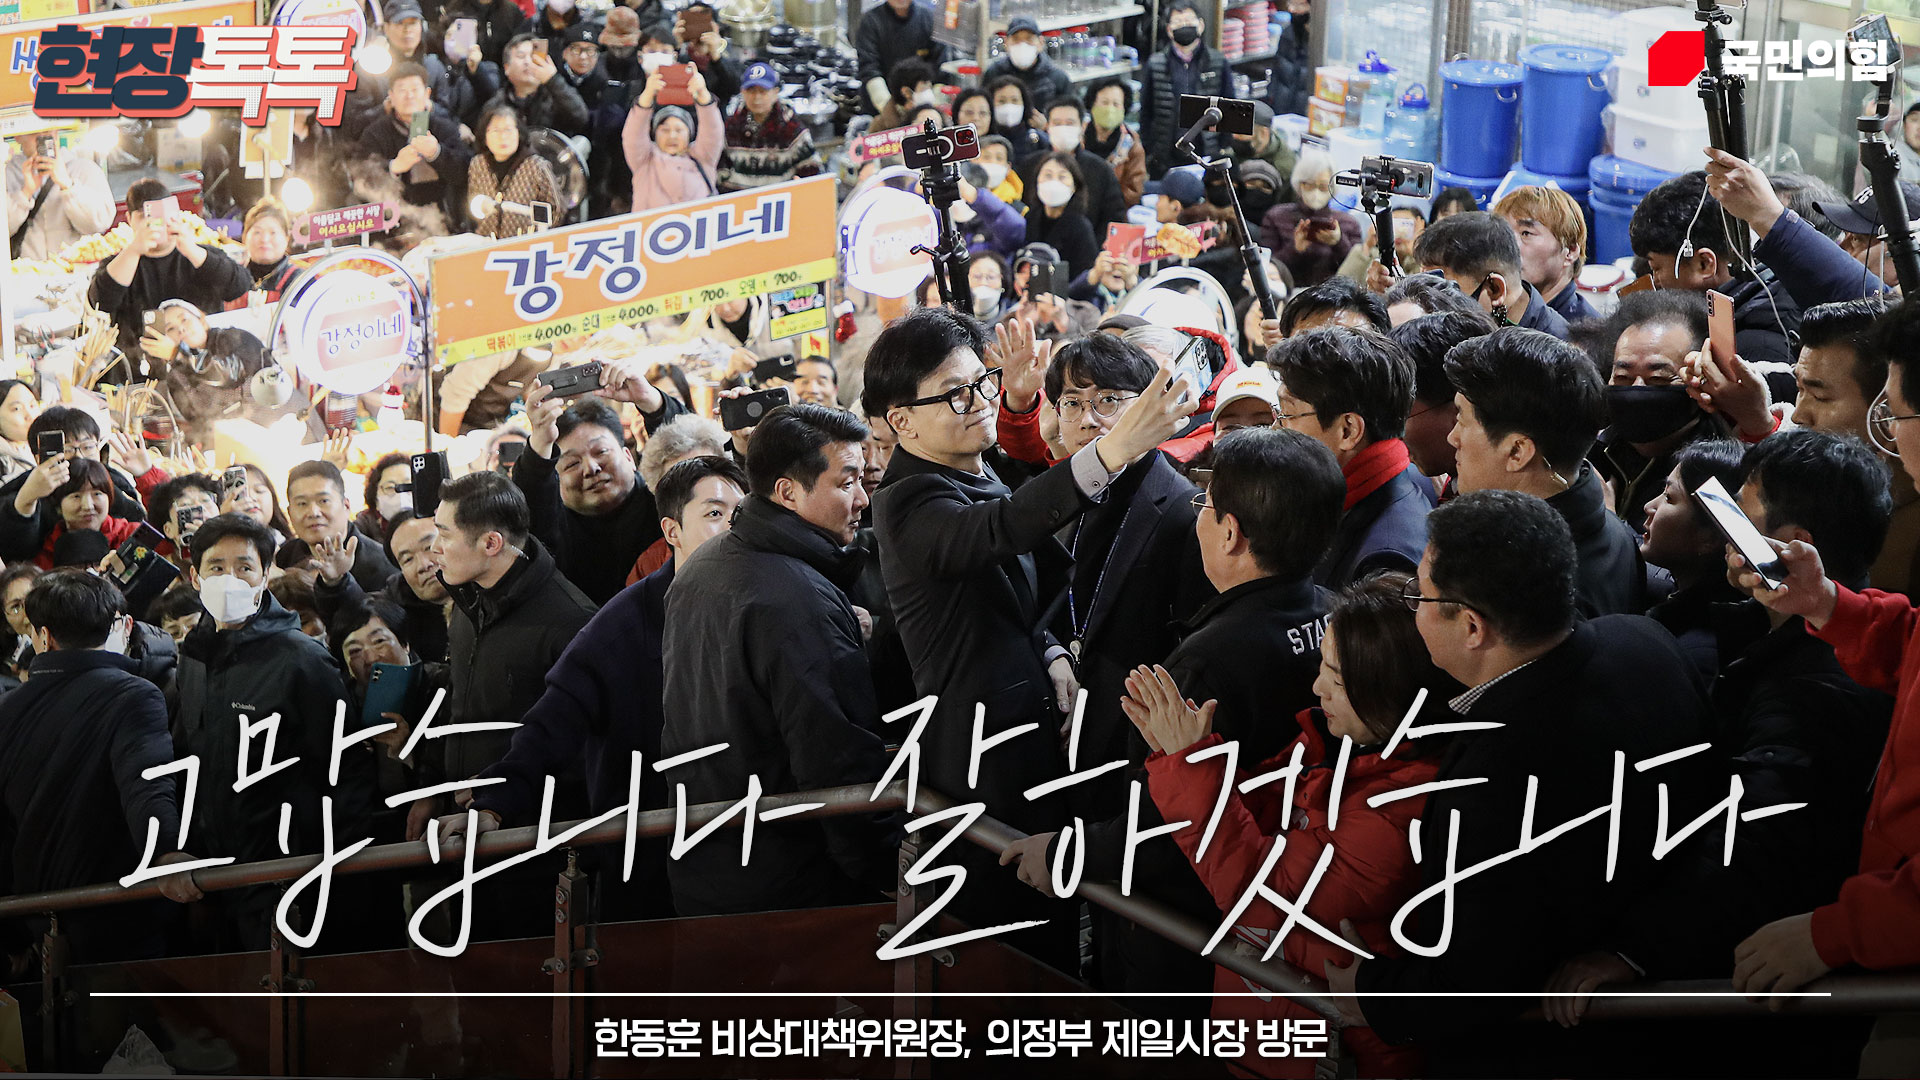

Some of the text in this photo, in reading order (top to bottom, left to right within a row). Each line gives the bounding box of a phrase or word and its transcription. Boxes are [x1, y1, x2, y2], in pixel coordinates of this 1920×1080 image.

[749, 65, 766, 79] D
[319, 218, 374, 237] 어서오십시오
[489, 197, 788, 317] 강정이네
[321, 313, 402, 354] 강정이네
[487, 333, 516, 351] 떡볶이
